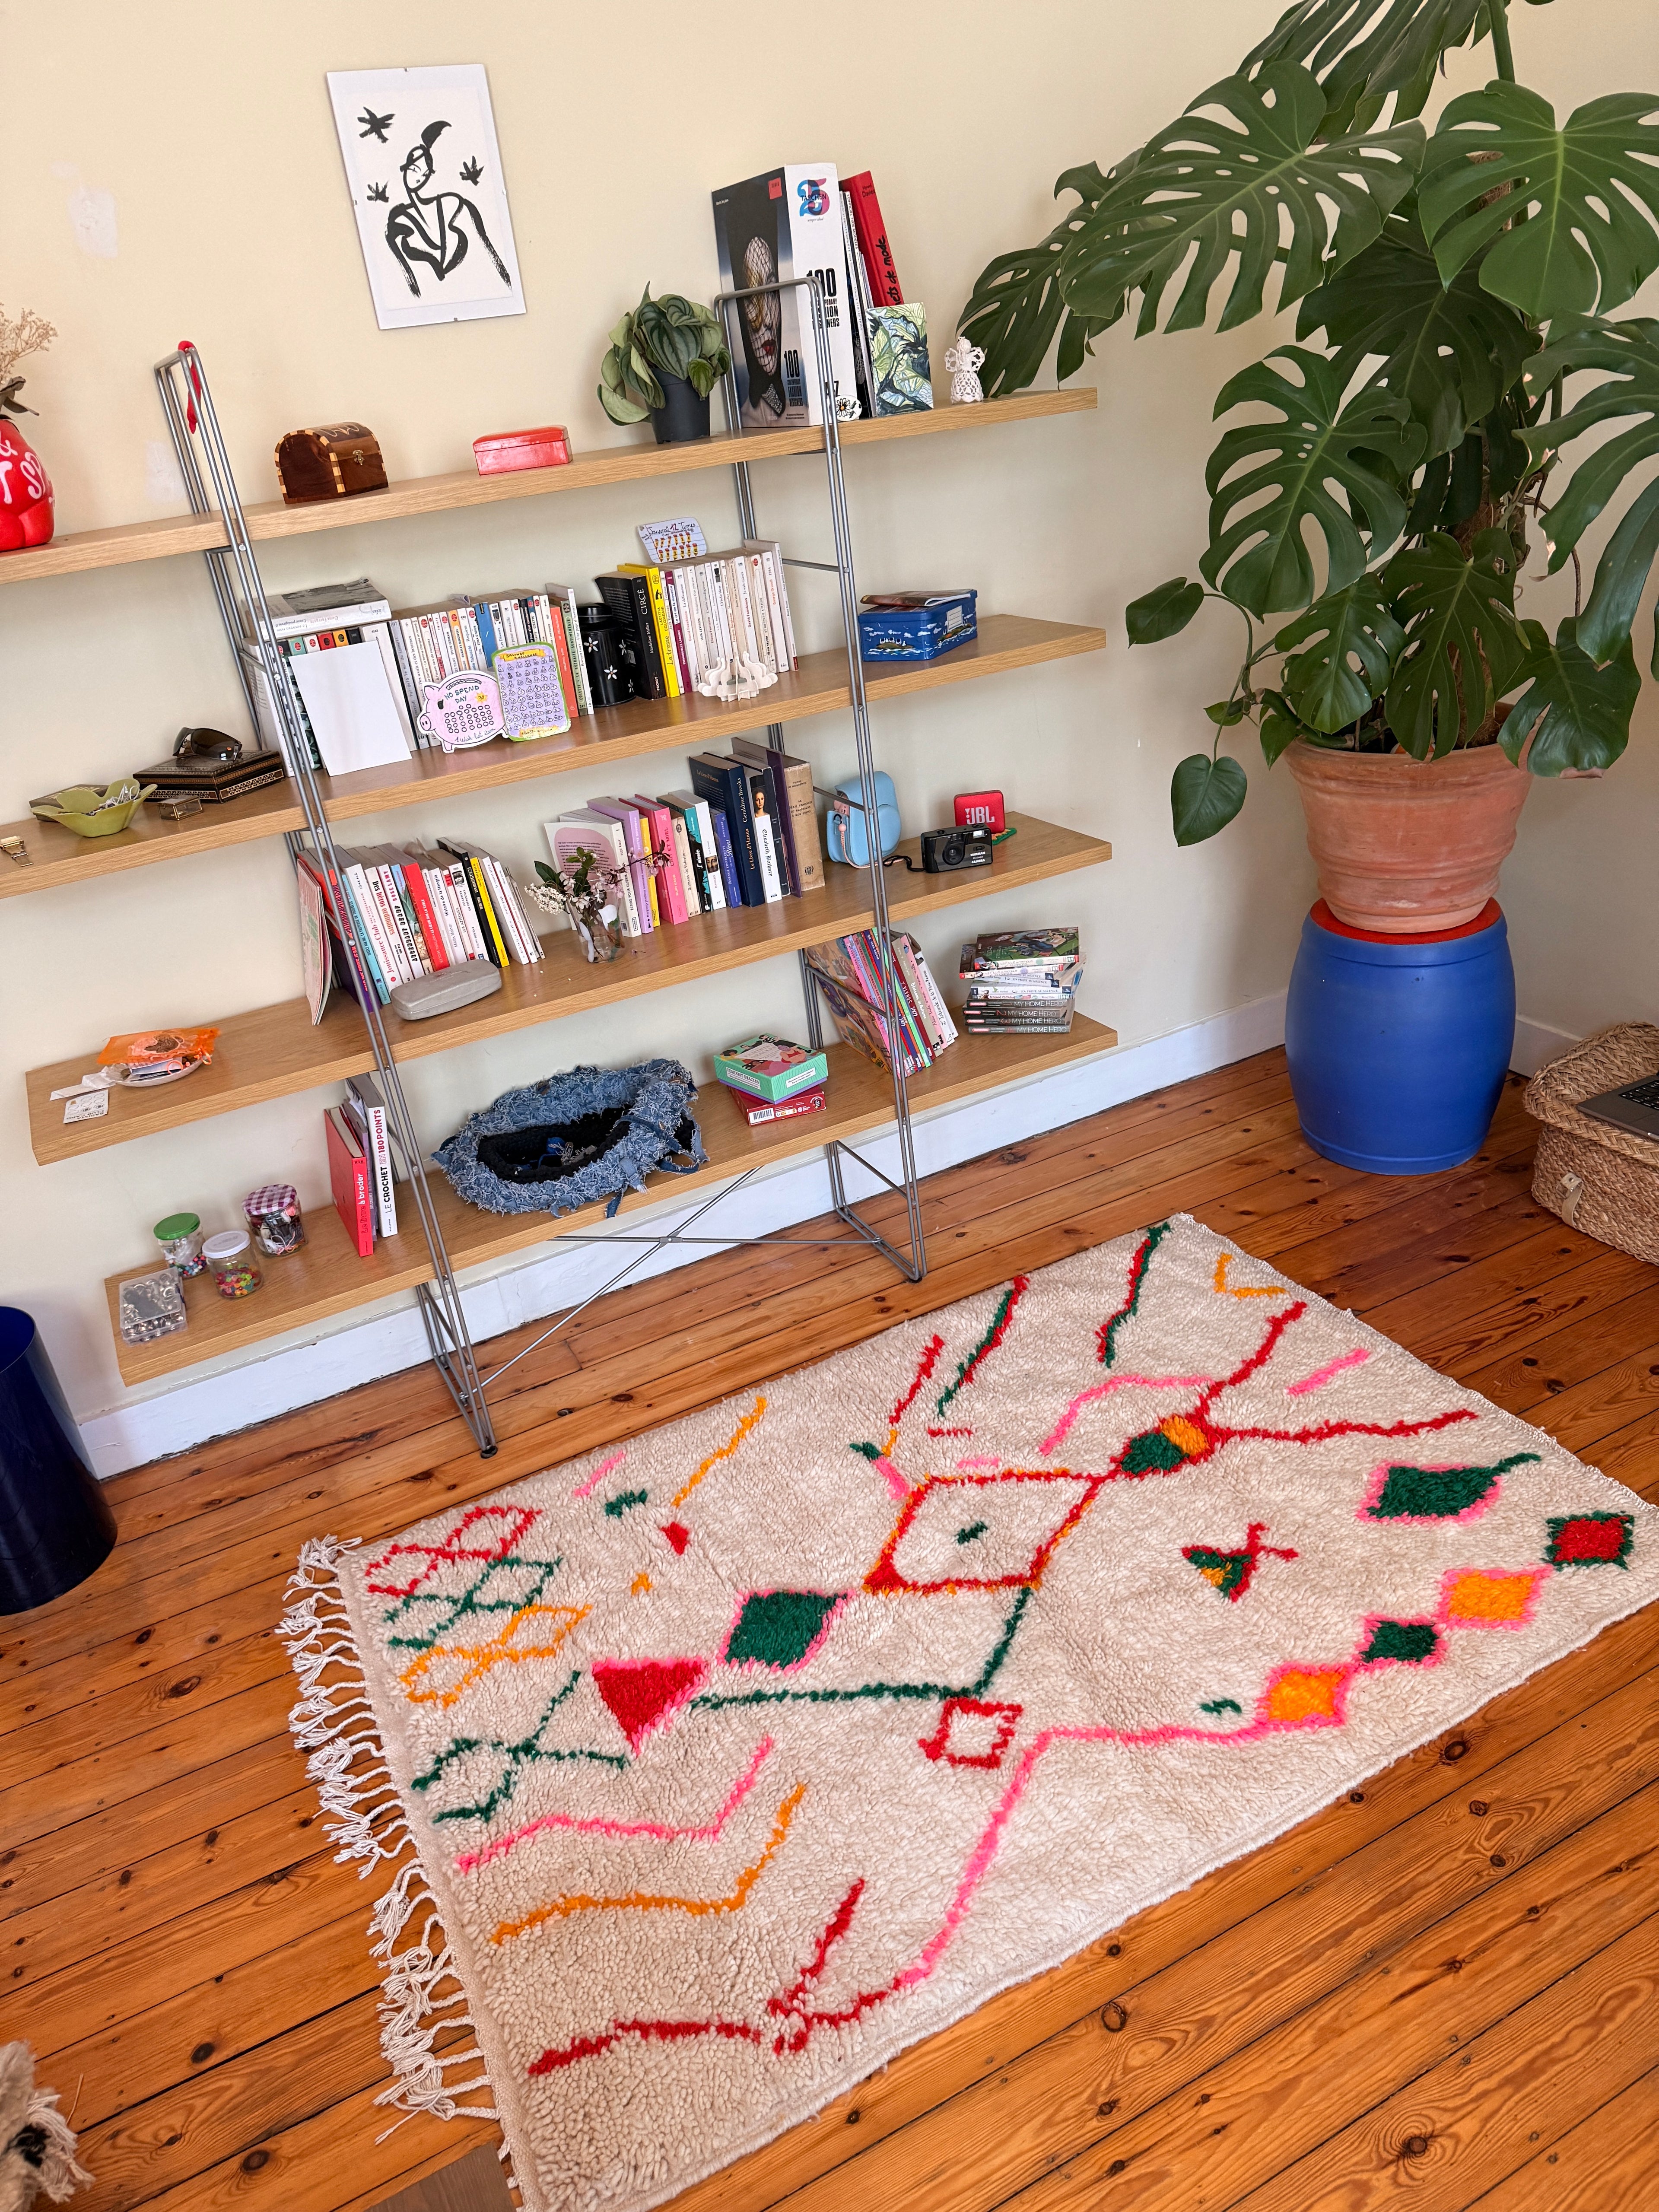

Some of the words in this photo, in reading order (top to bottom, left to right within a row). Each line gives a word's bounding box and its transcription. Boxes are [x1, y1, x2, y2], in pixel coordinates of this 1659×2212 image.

[862, 189, 875, 197] Davies
[873, 234, 893, 267] mode
[884, 269, 898, 285] de
[784, 350, 800, 378] 100
[678, 521, 695, 530] Times
[638, 588, 648, 615] CIRCÉ
[462, 625, 470, 642] Requiem
[566, 619, 575, 648] SENTIMENTALE
[407, 636, 415, 653] hommes
[662, 635, 671, 652] tresse
[665, 656, 673, 665] La
[455, 685, 479, 696] SPEND
[739, 796, 747, 822] Geraldine
[965, 806, 995, 825] JBL
[762, 829, 770, 854] Elisabeth
[694, 849, 702, 869] L'aimée
[372, 880, 381, 891] Des
[383, 870, 392, 886] LAMY
[433, 874, 442, 890] Hongrie
[375, 891, 387, 907] héros
[388, 887, 397, 901] ROSE
[381, 907, 397, 935] ordinaires
[394, 904, 406, 926] BEAUF
[370, 924, 381, 941] Club
[401, 927, 418, 962] ASCENDANT
[376, 939, 394, 974] Jouissance
[903, 985, 912, 1003] SONATA
[910, 982, 921, 1000] Blossoms
[727, 1068, 743, 1077] FEMINIST
[744, 1074, 759, 1084] ORACLES
[373, 1109, 383, 1139] POINTS
[378, 1154, 386, 1164] EN
[355, 1173, 365, 1199] broder
[380, 1166, 391, 1202] CROCHET
[358, 1206, 367, 1223] livre
[385, 1204, 391, 1213] LE
[361, 1223, 368, 1233] Le
